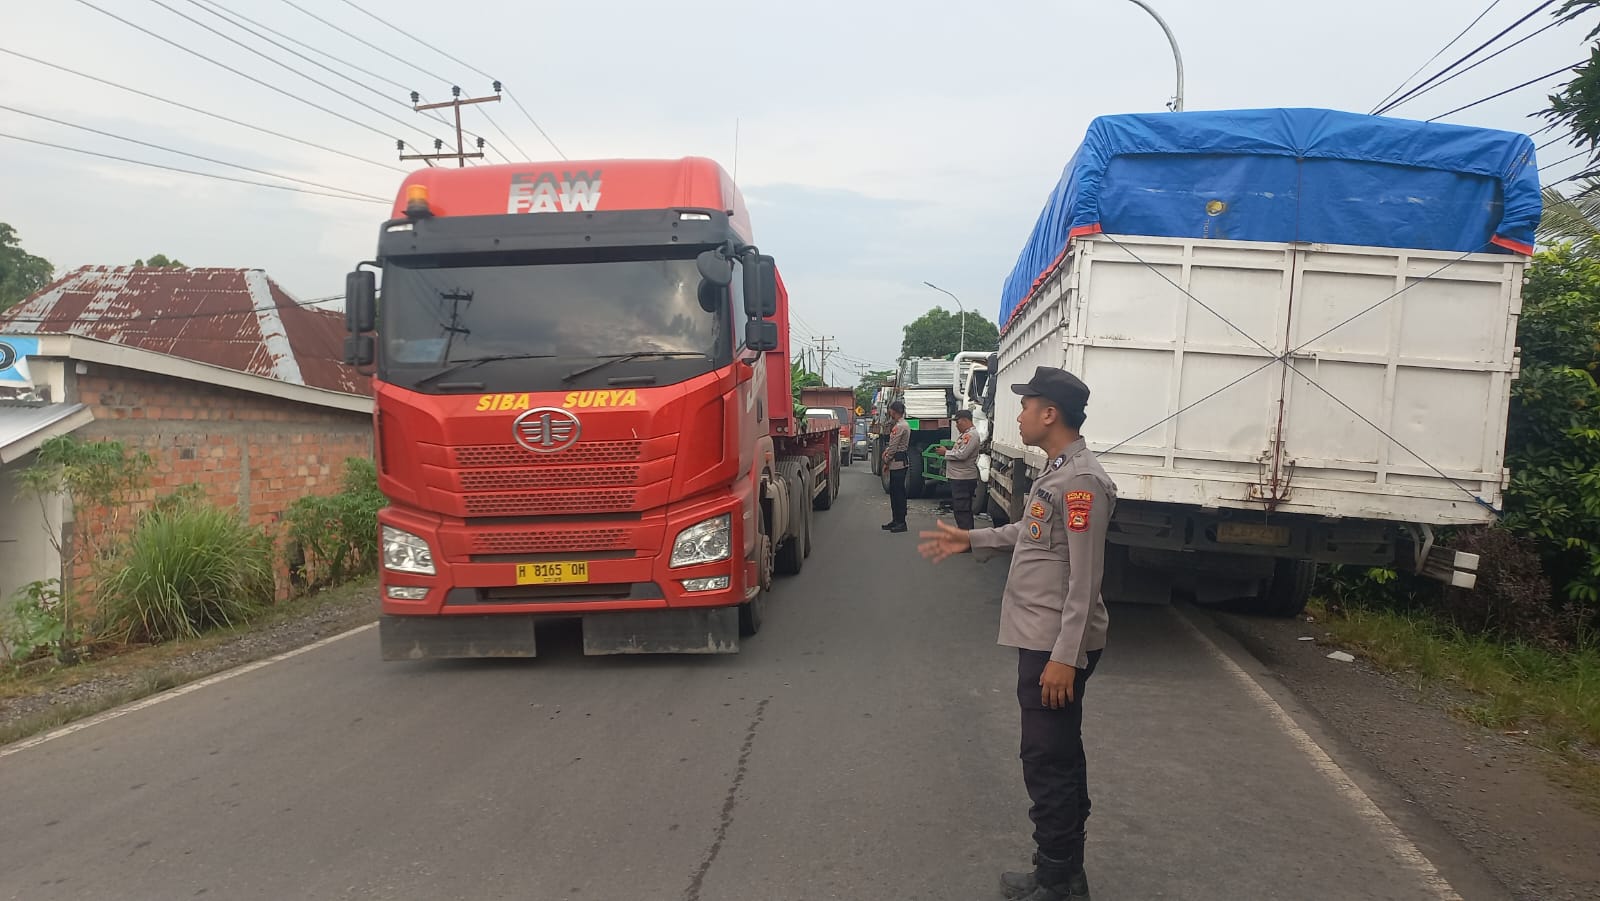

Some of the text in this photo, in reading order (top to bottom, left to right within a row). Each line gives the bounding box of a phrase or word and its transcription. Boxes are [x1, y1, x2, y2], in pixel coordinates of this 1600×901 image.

[507, 192, 602, 214] FAW
[475, 390, 637, 411] SIBA SURYA
[519, 563, 585, 578] H 8165 OH
